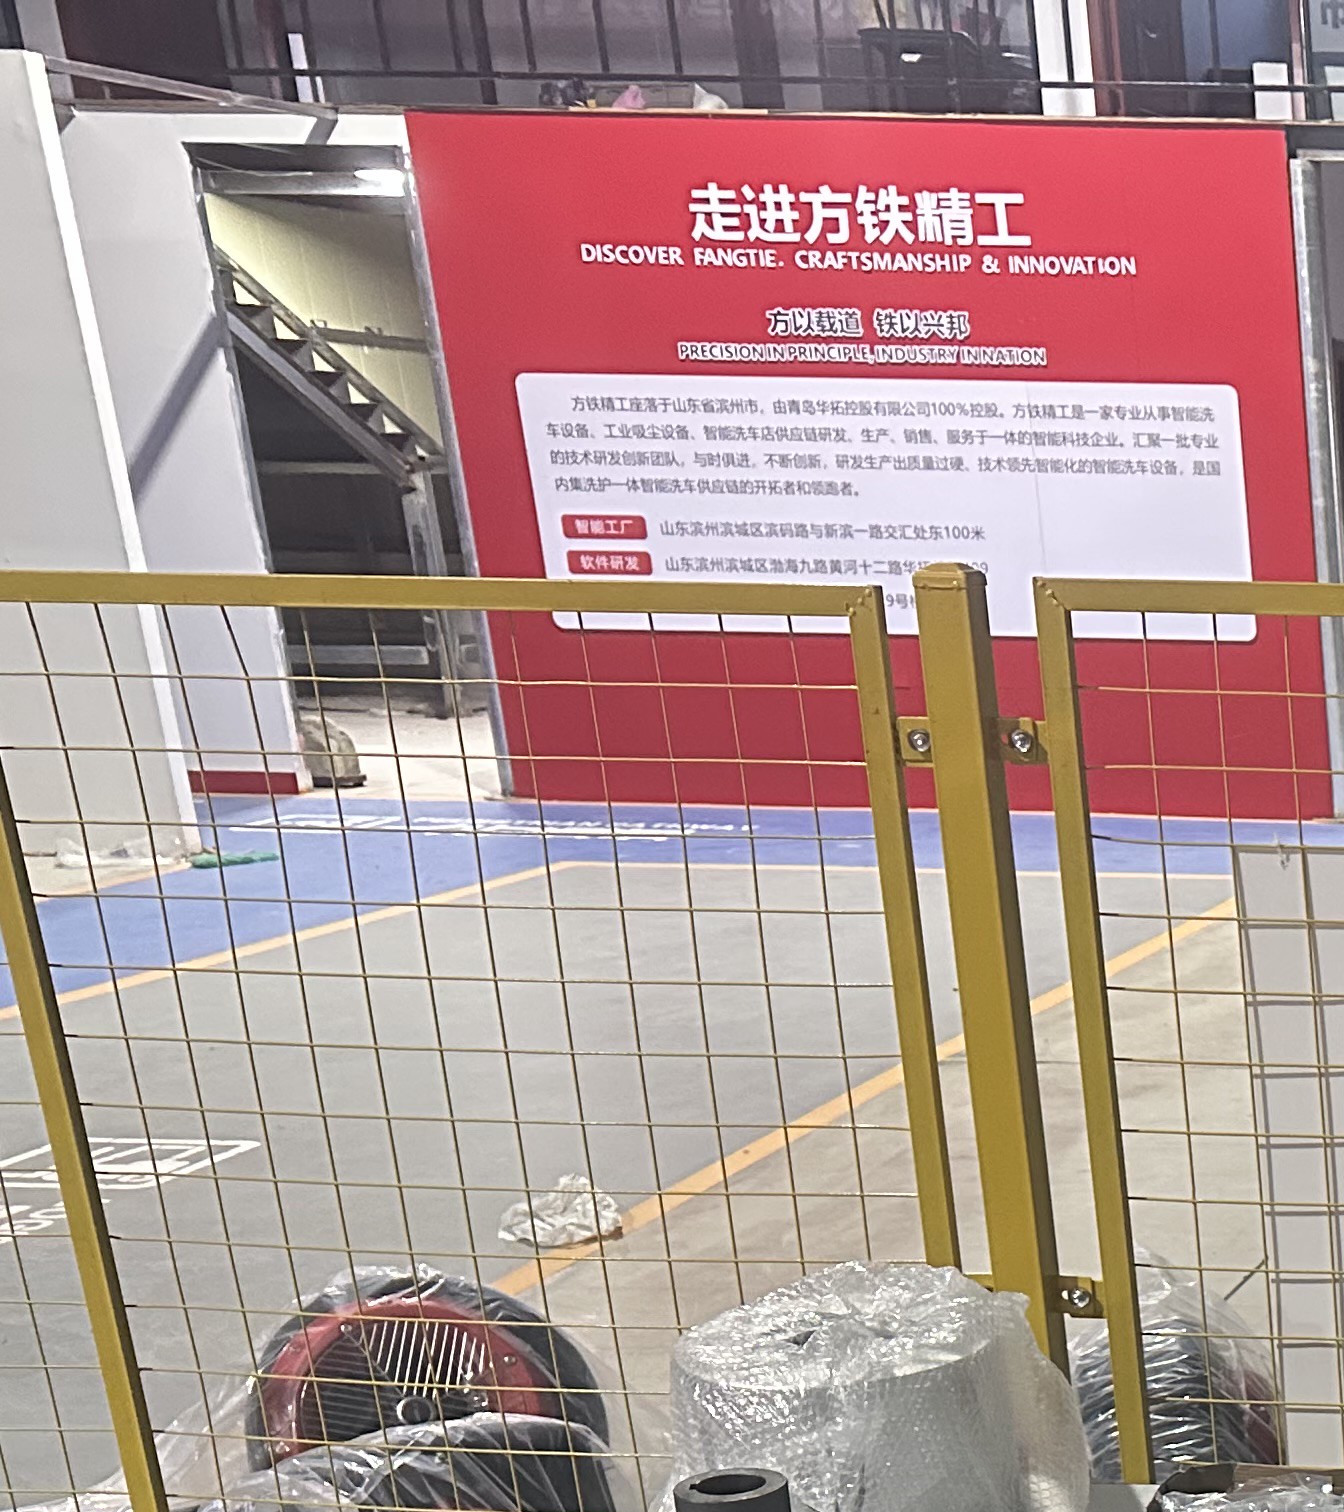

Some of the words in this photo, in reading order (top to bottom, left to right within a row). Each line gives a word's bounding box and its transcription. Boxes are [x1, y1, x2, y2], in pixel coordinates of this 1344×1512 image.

[689, 182, 1031, 248] 走进方铁精工
[580, 243, 684, 266] DISCOVER
[693, 249, 785, 269] FANGTIE.
[794, 250, 972, 274] CRAFTSMANSHIP
[981, 255, 1000, 274] &
[1008, 255, 1137, 277] INNOVATION
[767, 307, 863, 337] 方以载道
[874, 308, 971, 339] 铁以兴邦
